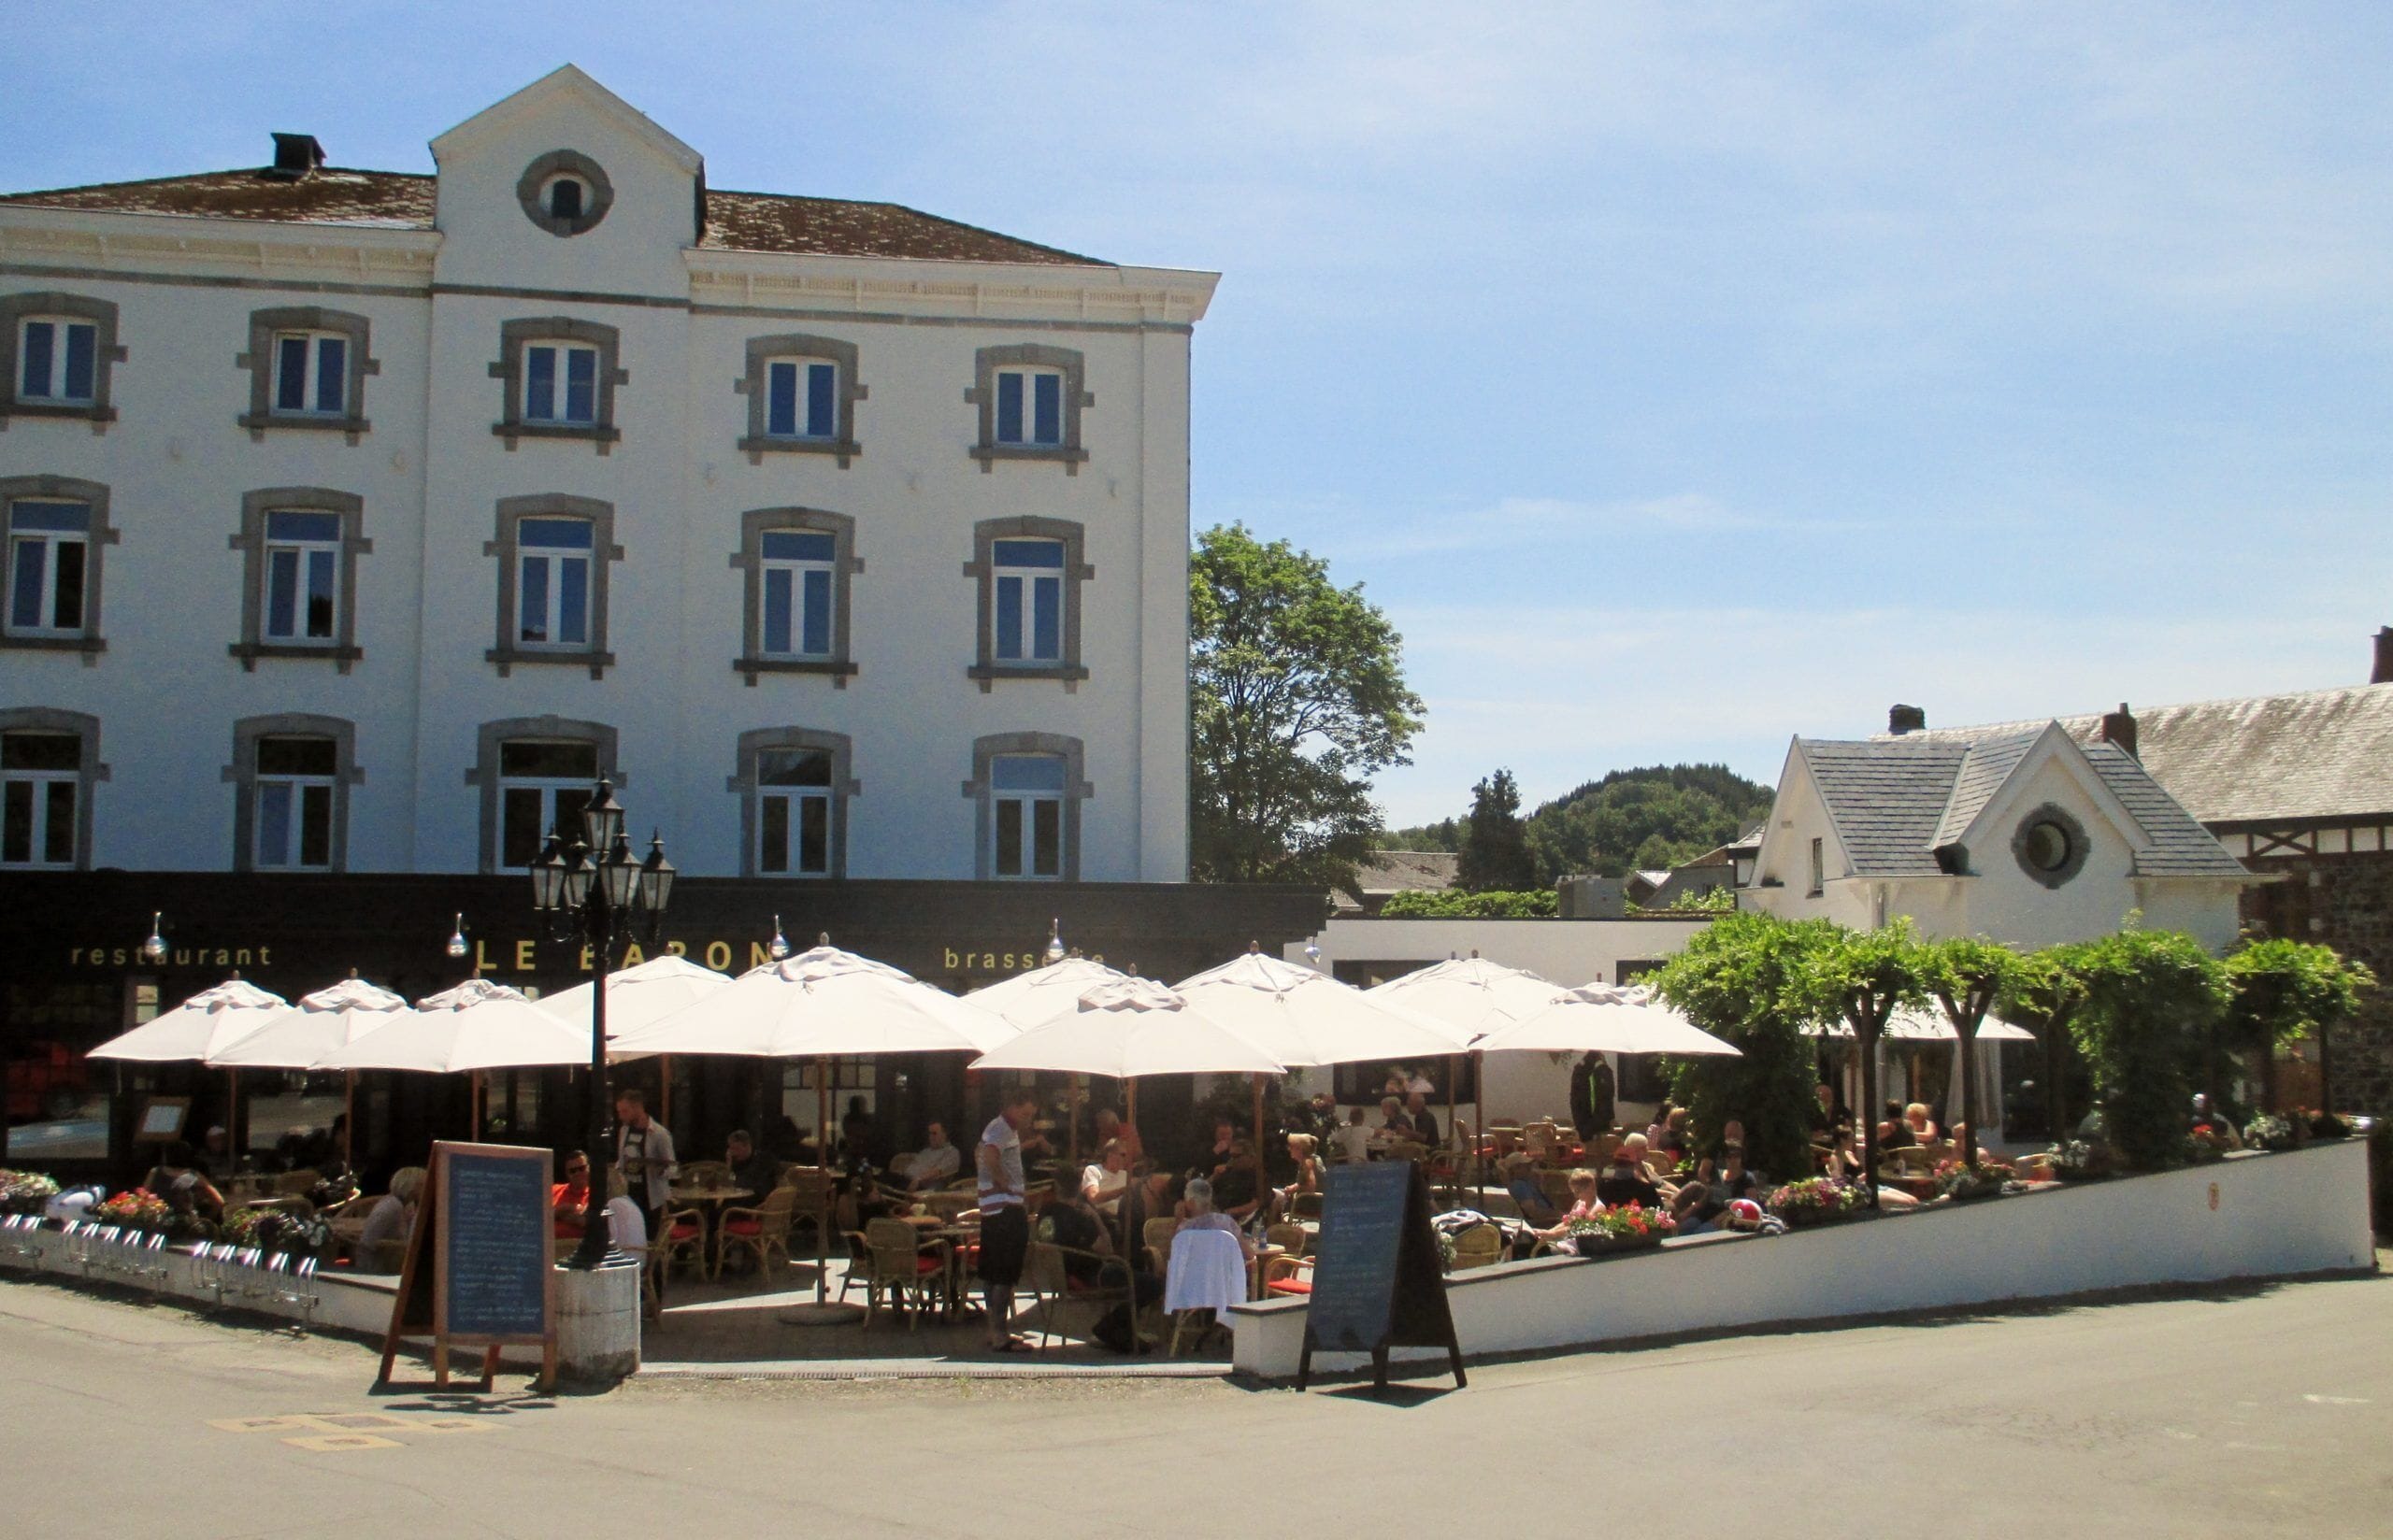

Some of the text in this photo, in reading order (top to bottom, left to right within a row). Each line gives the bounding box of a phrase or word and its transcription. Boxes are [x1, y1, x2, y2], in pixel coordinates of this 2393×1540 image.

[72, 946, 271, 965] restaurant
[476, 940, 536, 971] LE
[945, 948, 1104, 969] brassee
